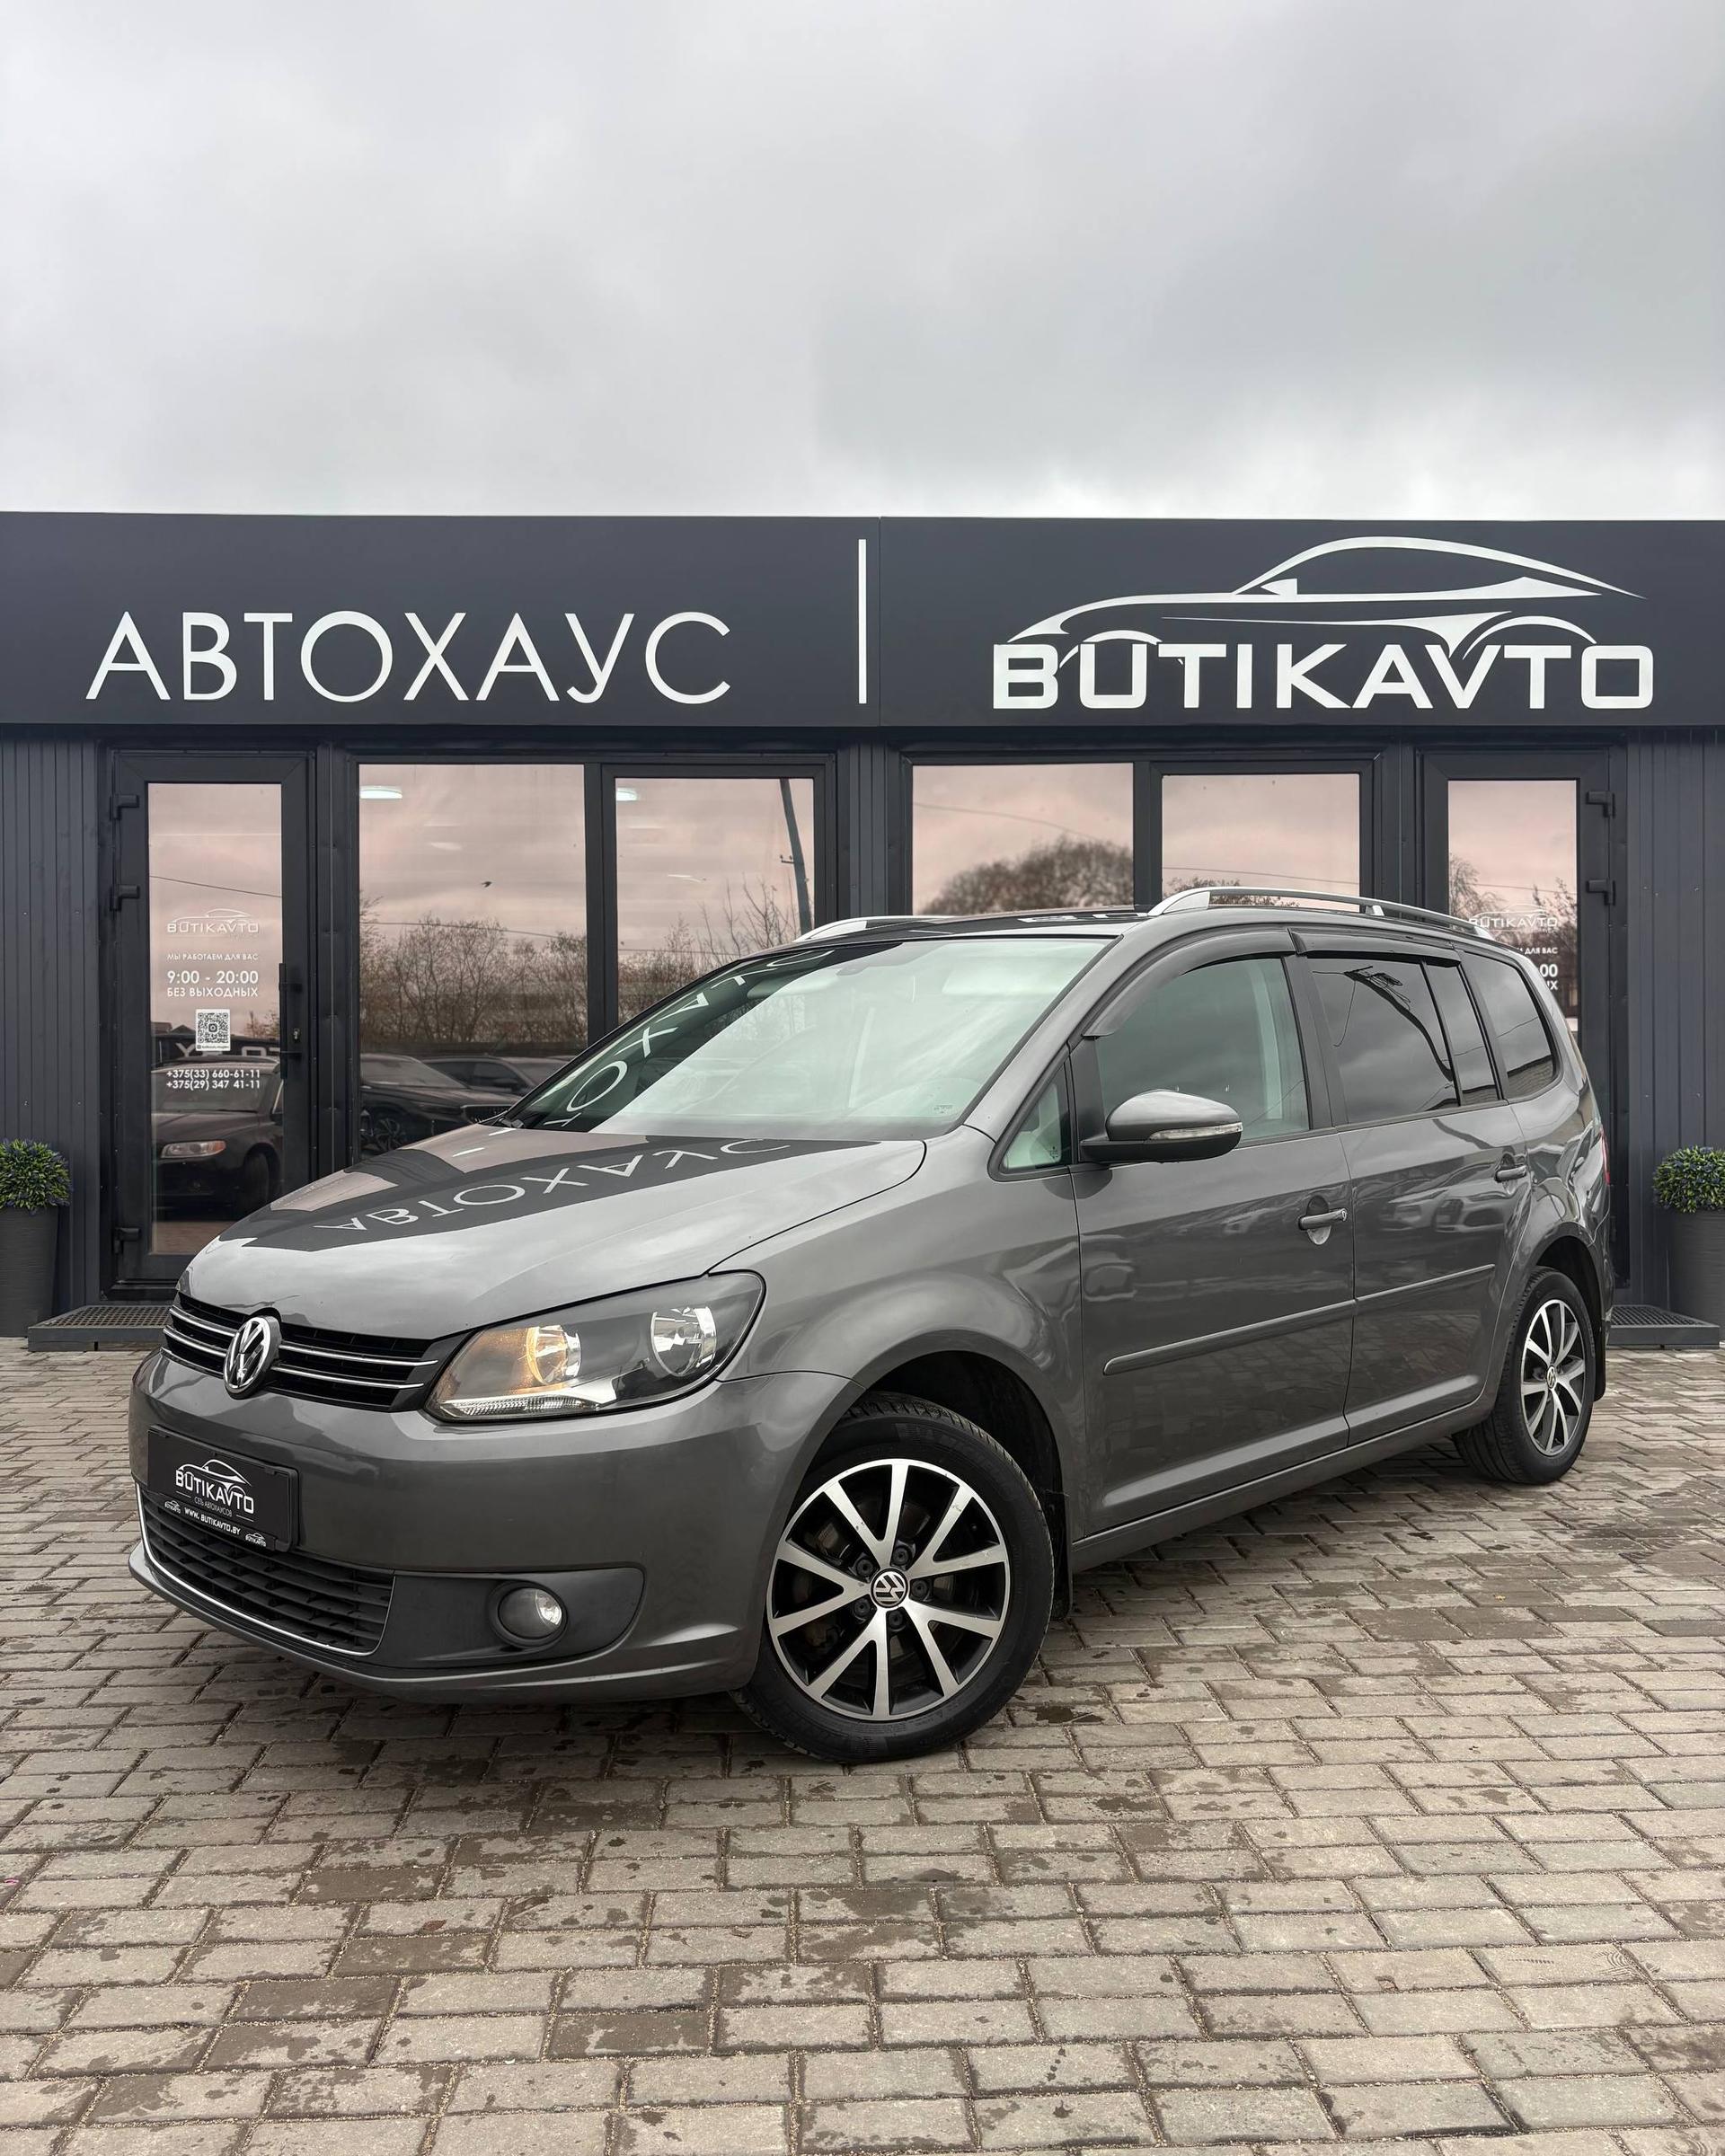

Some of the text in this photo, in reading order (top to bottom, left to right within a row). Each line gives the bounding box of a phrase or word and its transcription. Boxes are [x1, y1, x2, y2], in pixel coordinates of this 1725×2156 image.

[86, 611, 730, 704] АВТОХАУС
[993, 643, 1653, 709] BUTIKAVTO
[167, 922, 259, 933] BUTIKAVTO
[1542, 947, 1558, 955] ВАС
[182, 953, 223, 961] РАБОТАЕМ
[225, 953, 241, 961] ДЛЯ
[242, 953, 259, 961] ВАС
[167, 970, 199, 984] 9:00
[217, 970, 259, 984] 20:00
[167, 987, 259, 998] БЕЗ ВЫХОДНЫХ
[166, 1069, 260, 1080] +375(33) 660-61-11
[166, 1080, 260, 1091] +375(29) 347 41-11
[175, 1470, 254, 1515] BUTIKAVTO
